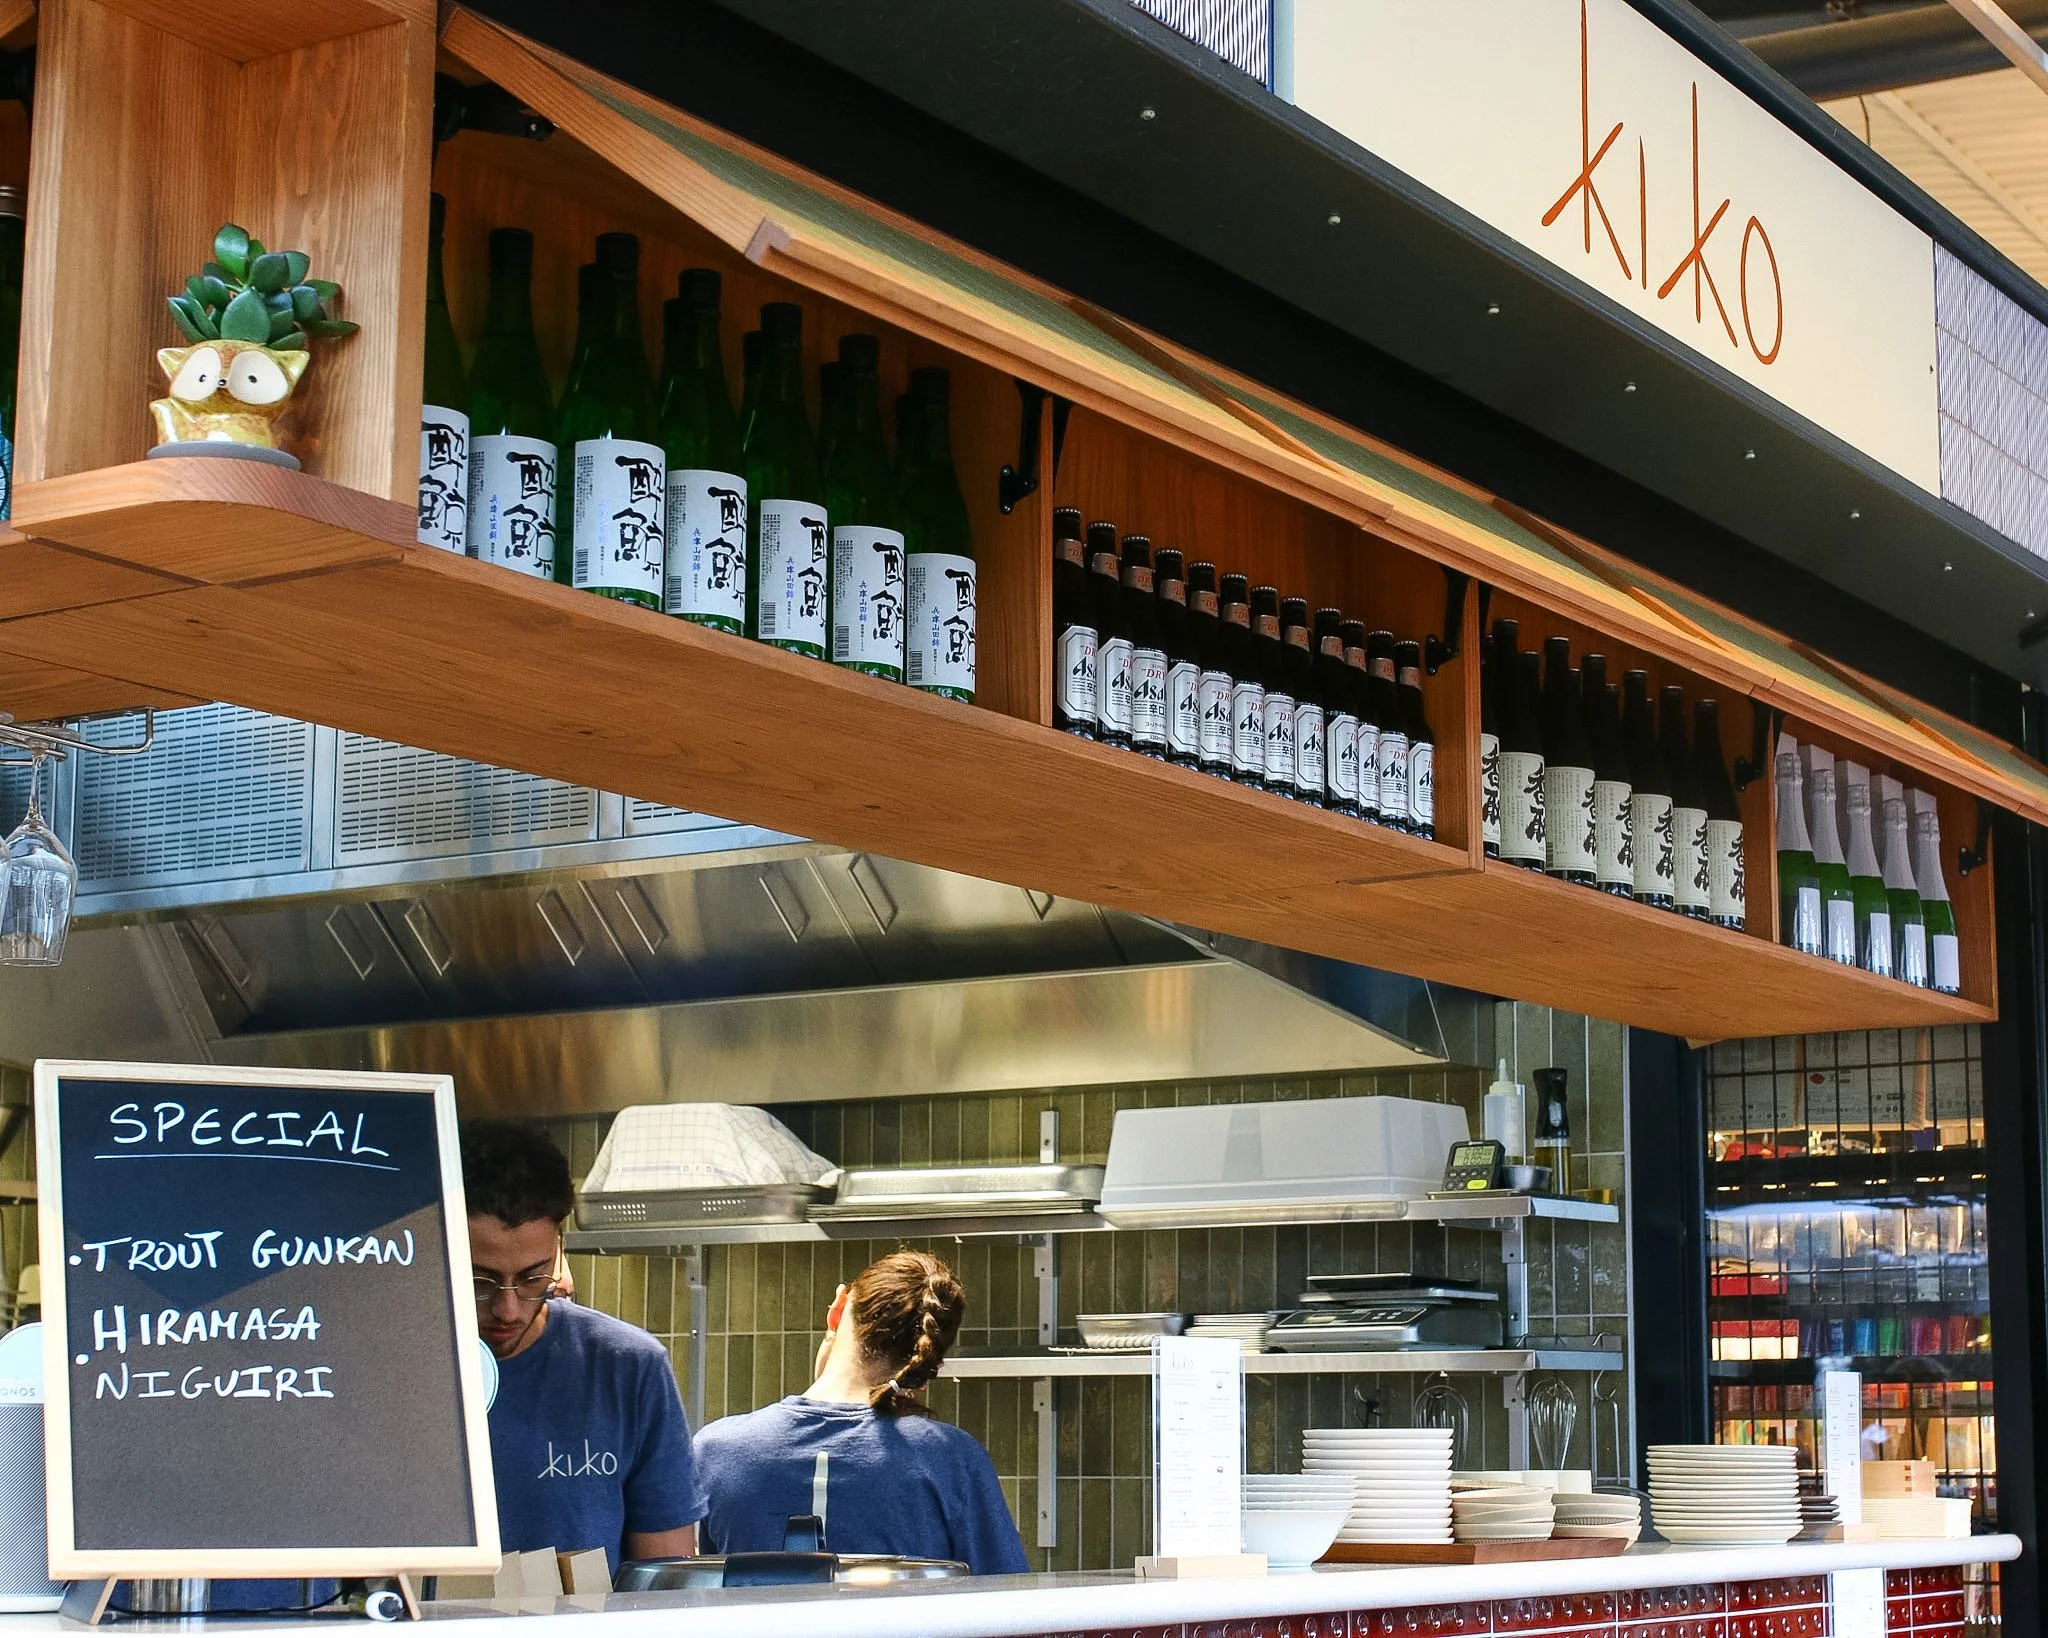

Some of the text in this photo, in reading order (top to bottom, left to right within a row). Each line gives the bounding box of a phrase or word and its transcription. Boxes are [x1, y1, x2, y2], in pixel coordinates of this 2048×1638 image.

[1541, 0, 1783, 365] kiko
[1149, 704, 1165, 716] 辛口
[109, 1102, 390, 1158] SPECIAL
[83, 1227, 416, 1273] TROUT GUNKAN
[92, 1304, 322, 1354] HIRAMASA
[94, 1362, 336, 1402] NIGUIRI
[537, 1438, 618, 1479] kiko
